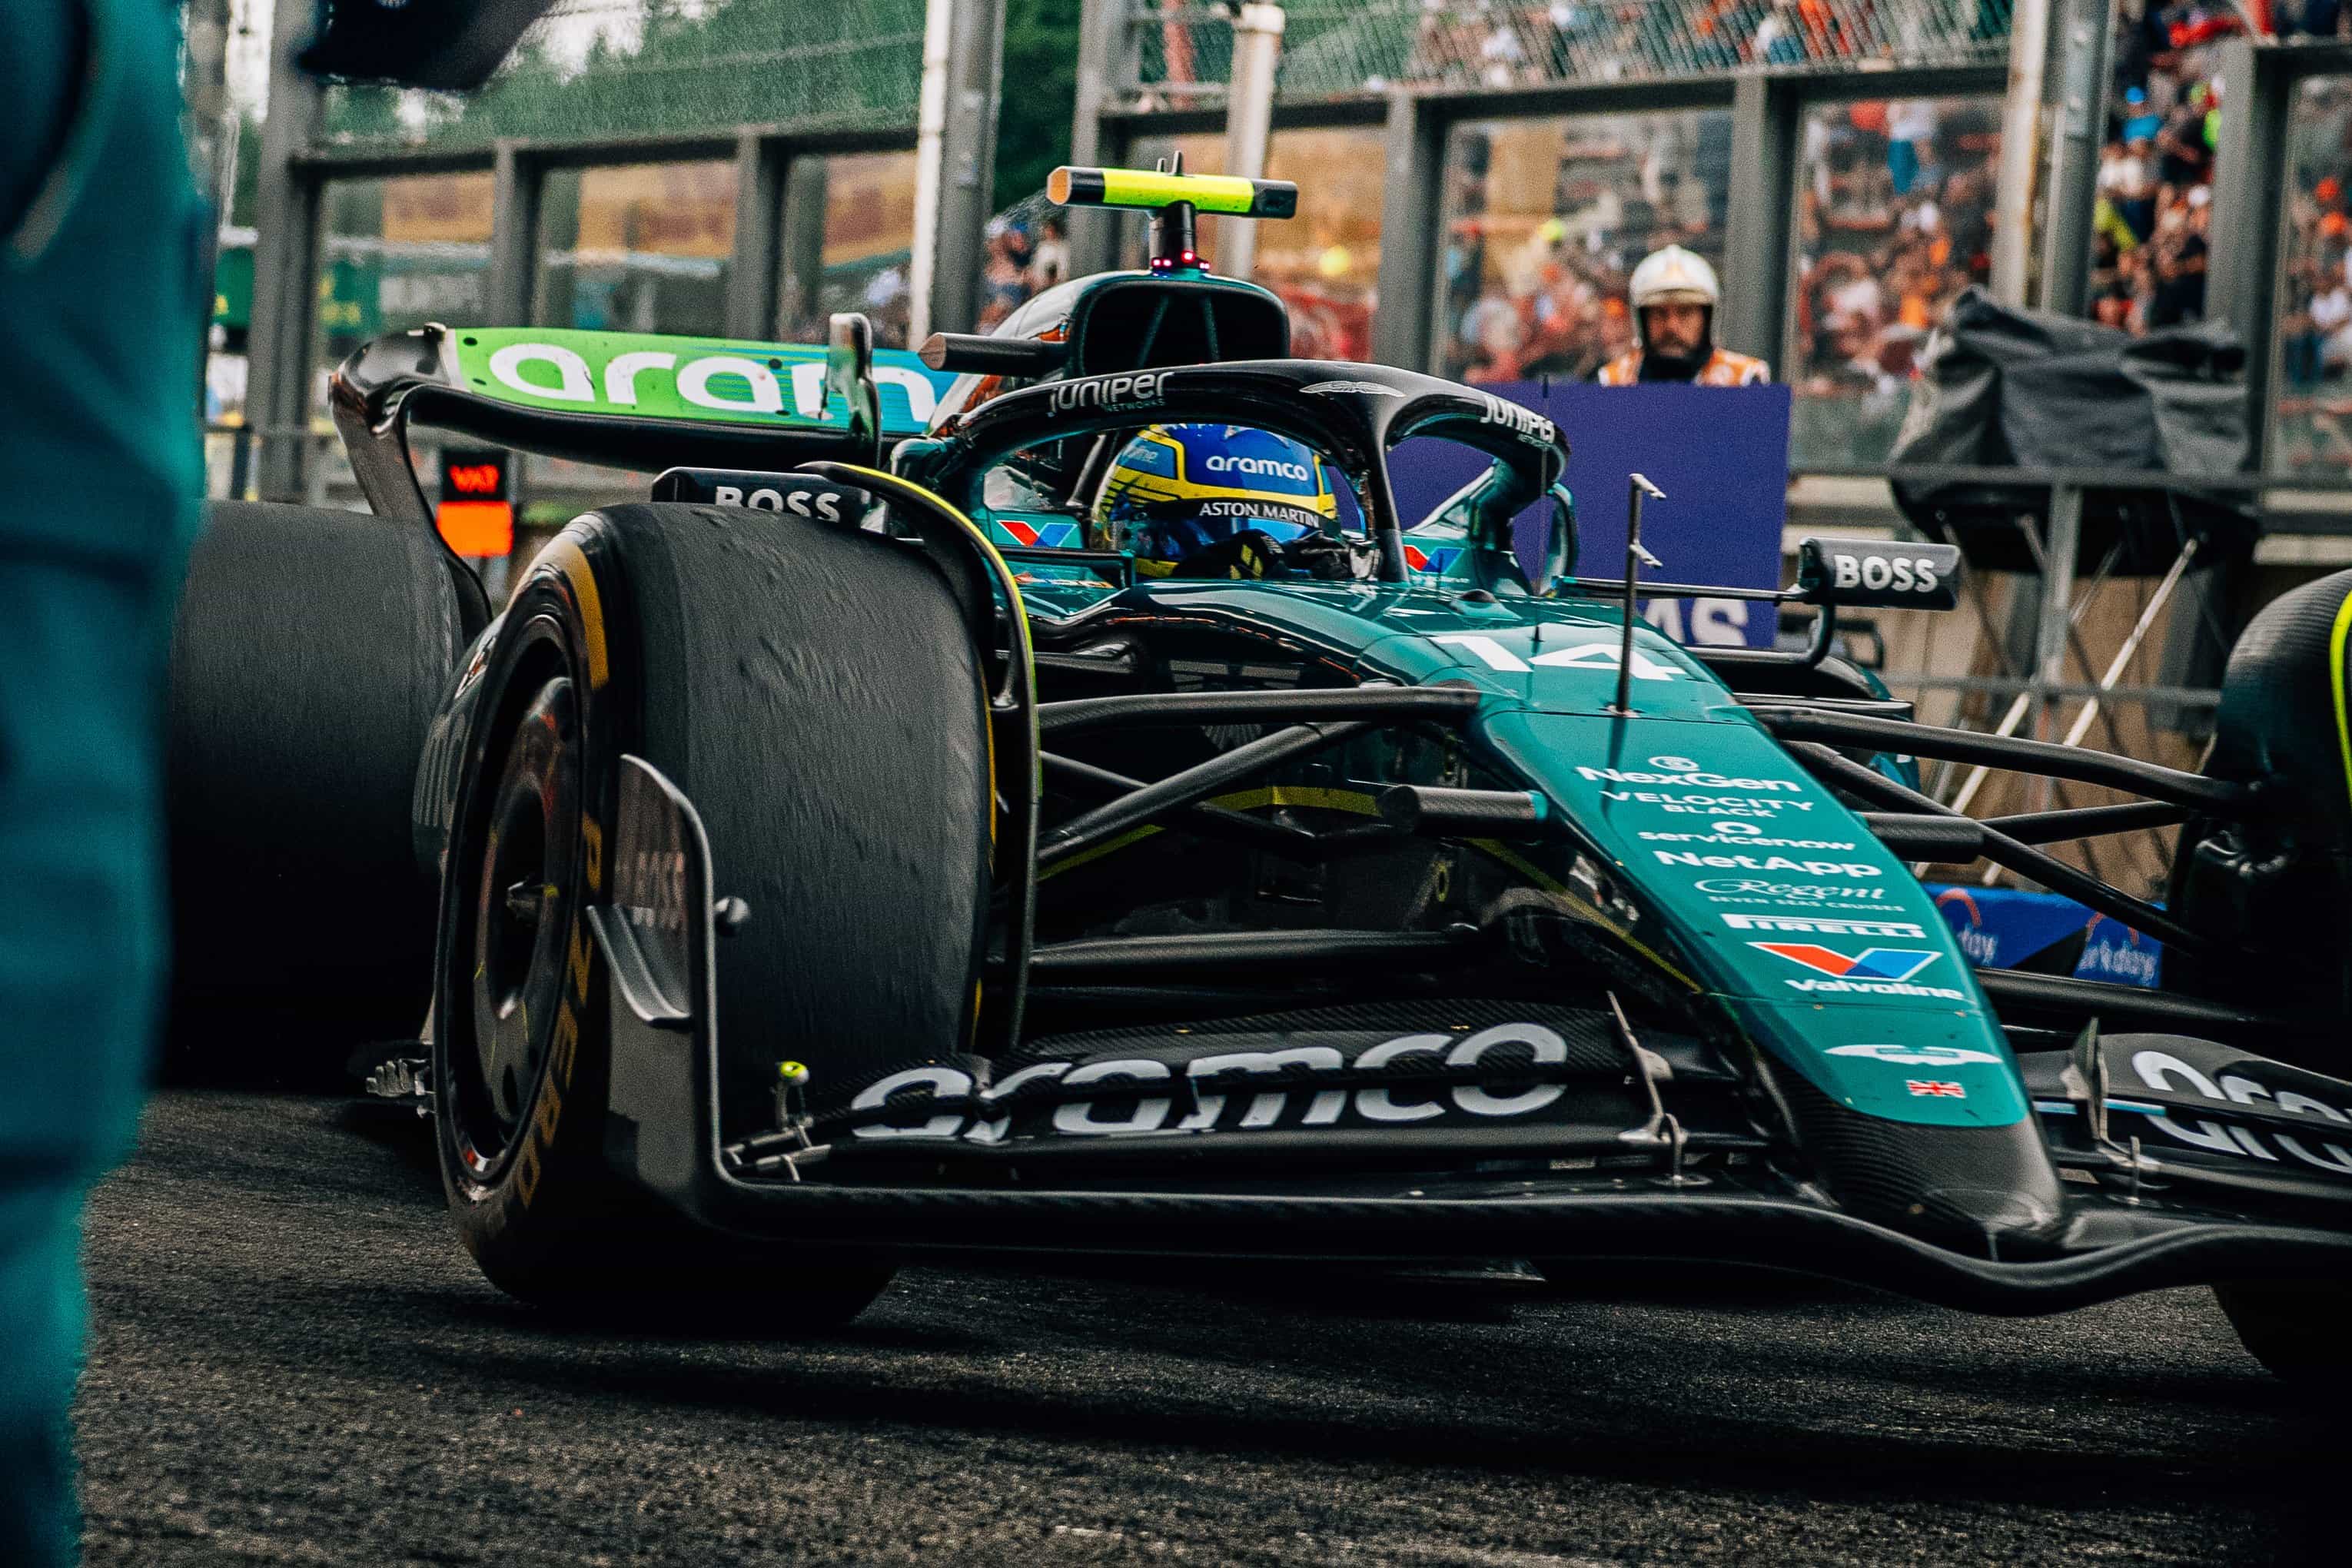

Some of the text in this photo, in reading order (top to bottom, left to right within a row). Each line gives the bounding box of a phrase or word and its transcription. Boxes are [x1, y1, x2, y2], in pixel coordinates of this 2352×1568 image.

[1205, 456, 1308, 482] aramco
[715, 486, 841, 523] BOSS
[1199, 501, 1320, 528] ASTON MARTIN
[1834, 546, 1938, 593] BOSS
[1427, 636, 1687, 681] 14
[1576, 766, 1802, 792] NexGen
[1599, 790, 1815, 812] VELOCITY
[1661, 803, 1777, 818] BLACK
[1637, 831, 1855, 851] servicenow
[1653, 850, 1882, 878] NetApp
[1720, 913, 1927, 938] PIRELLI
[851, 1023, 1567, 1144] aramco
[2131, 1051, 2352, 1174] ara
